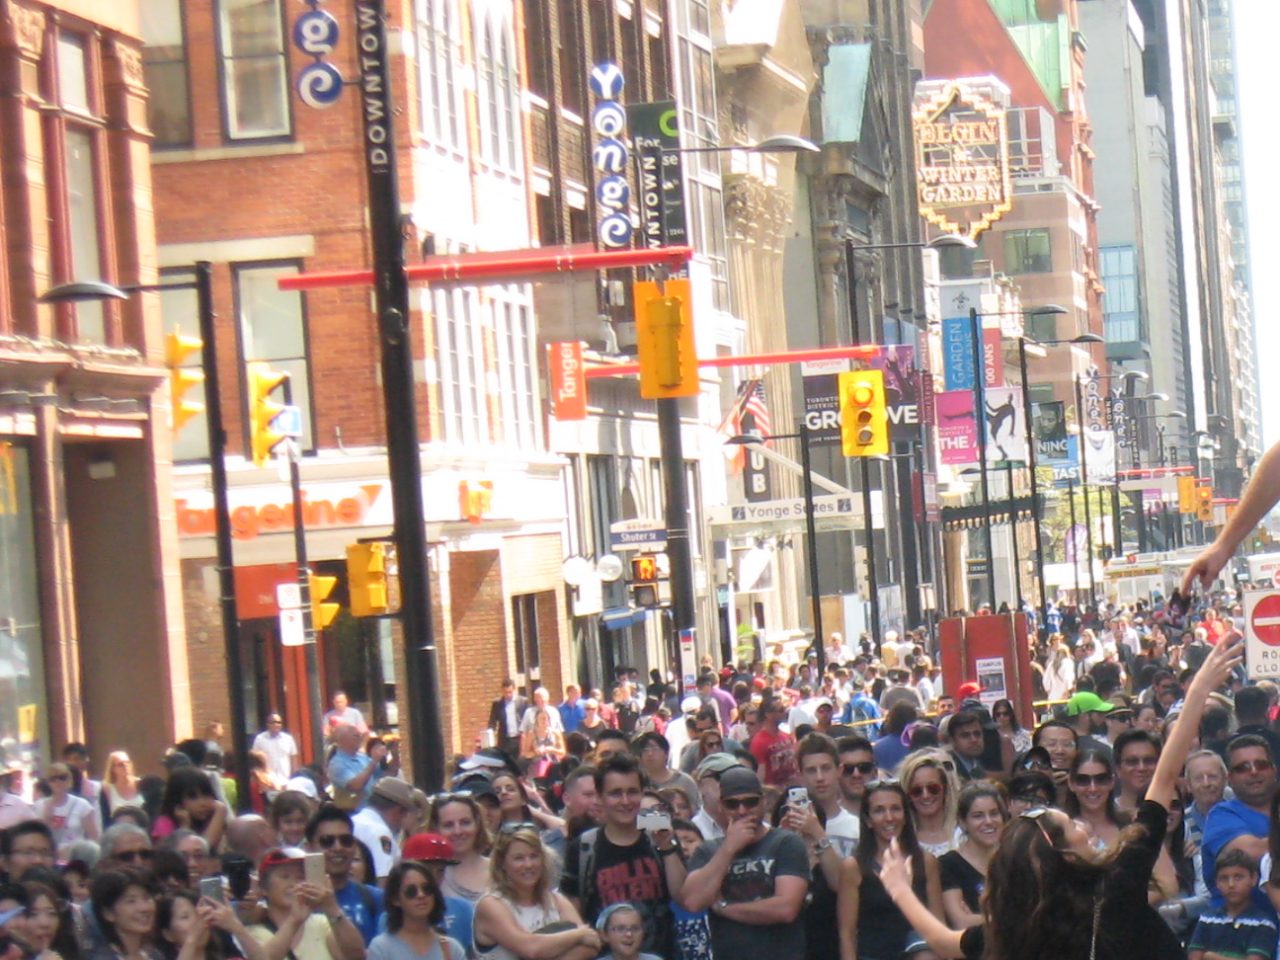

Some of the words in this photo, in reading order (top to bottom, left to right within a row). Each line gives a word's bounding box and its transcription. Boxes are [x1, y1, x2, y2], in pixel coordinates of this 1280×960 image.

[919, 120, 998, 144] ELGIN
[589, 63, 632, 248] Yonge
[919, 166, 1001, 185] WINTER
[921, 184, 1002, 203] GARDEN
[805, 405, 919, 431] GRVE
[939, 435, 970, 451] THE
[748, 506, 790, 518] Yonge
[793, 502, 834, 516] Sutes
[620, 533, 647, 543] Shuter
